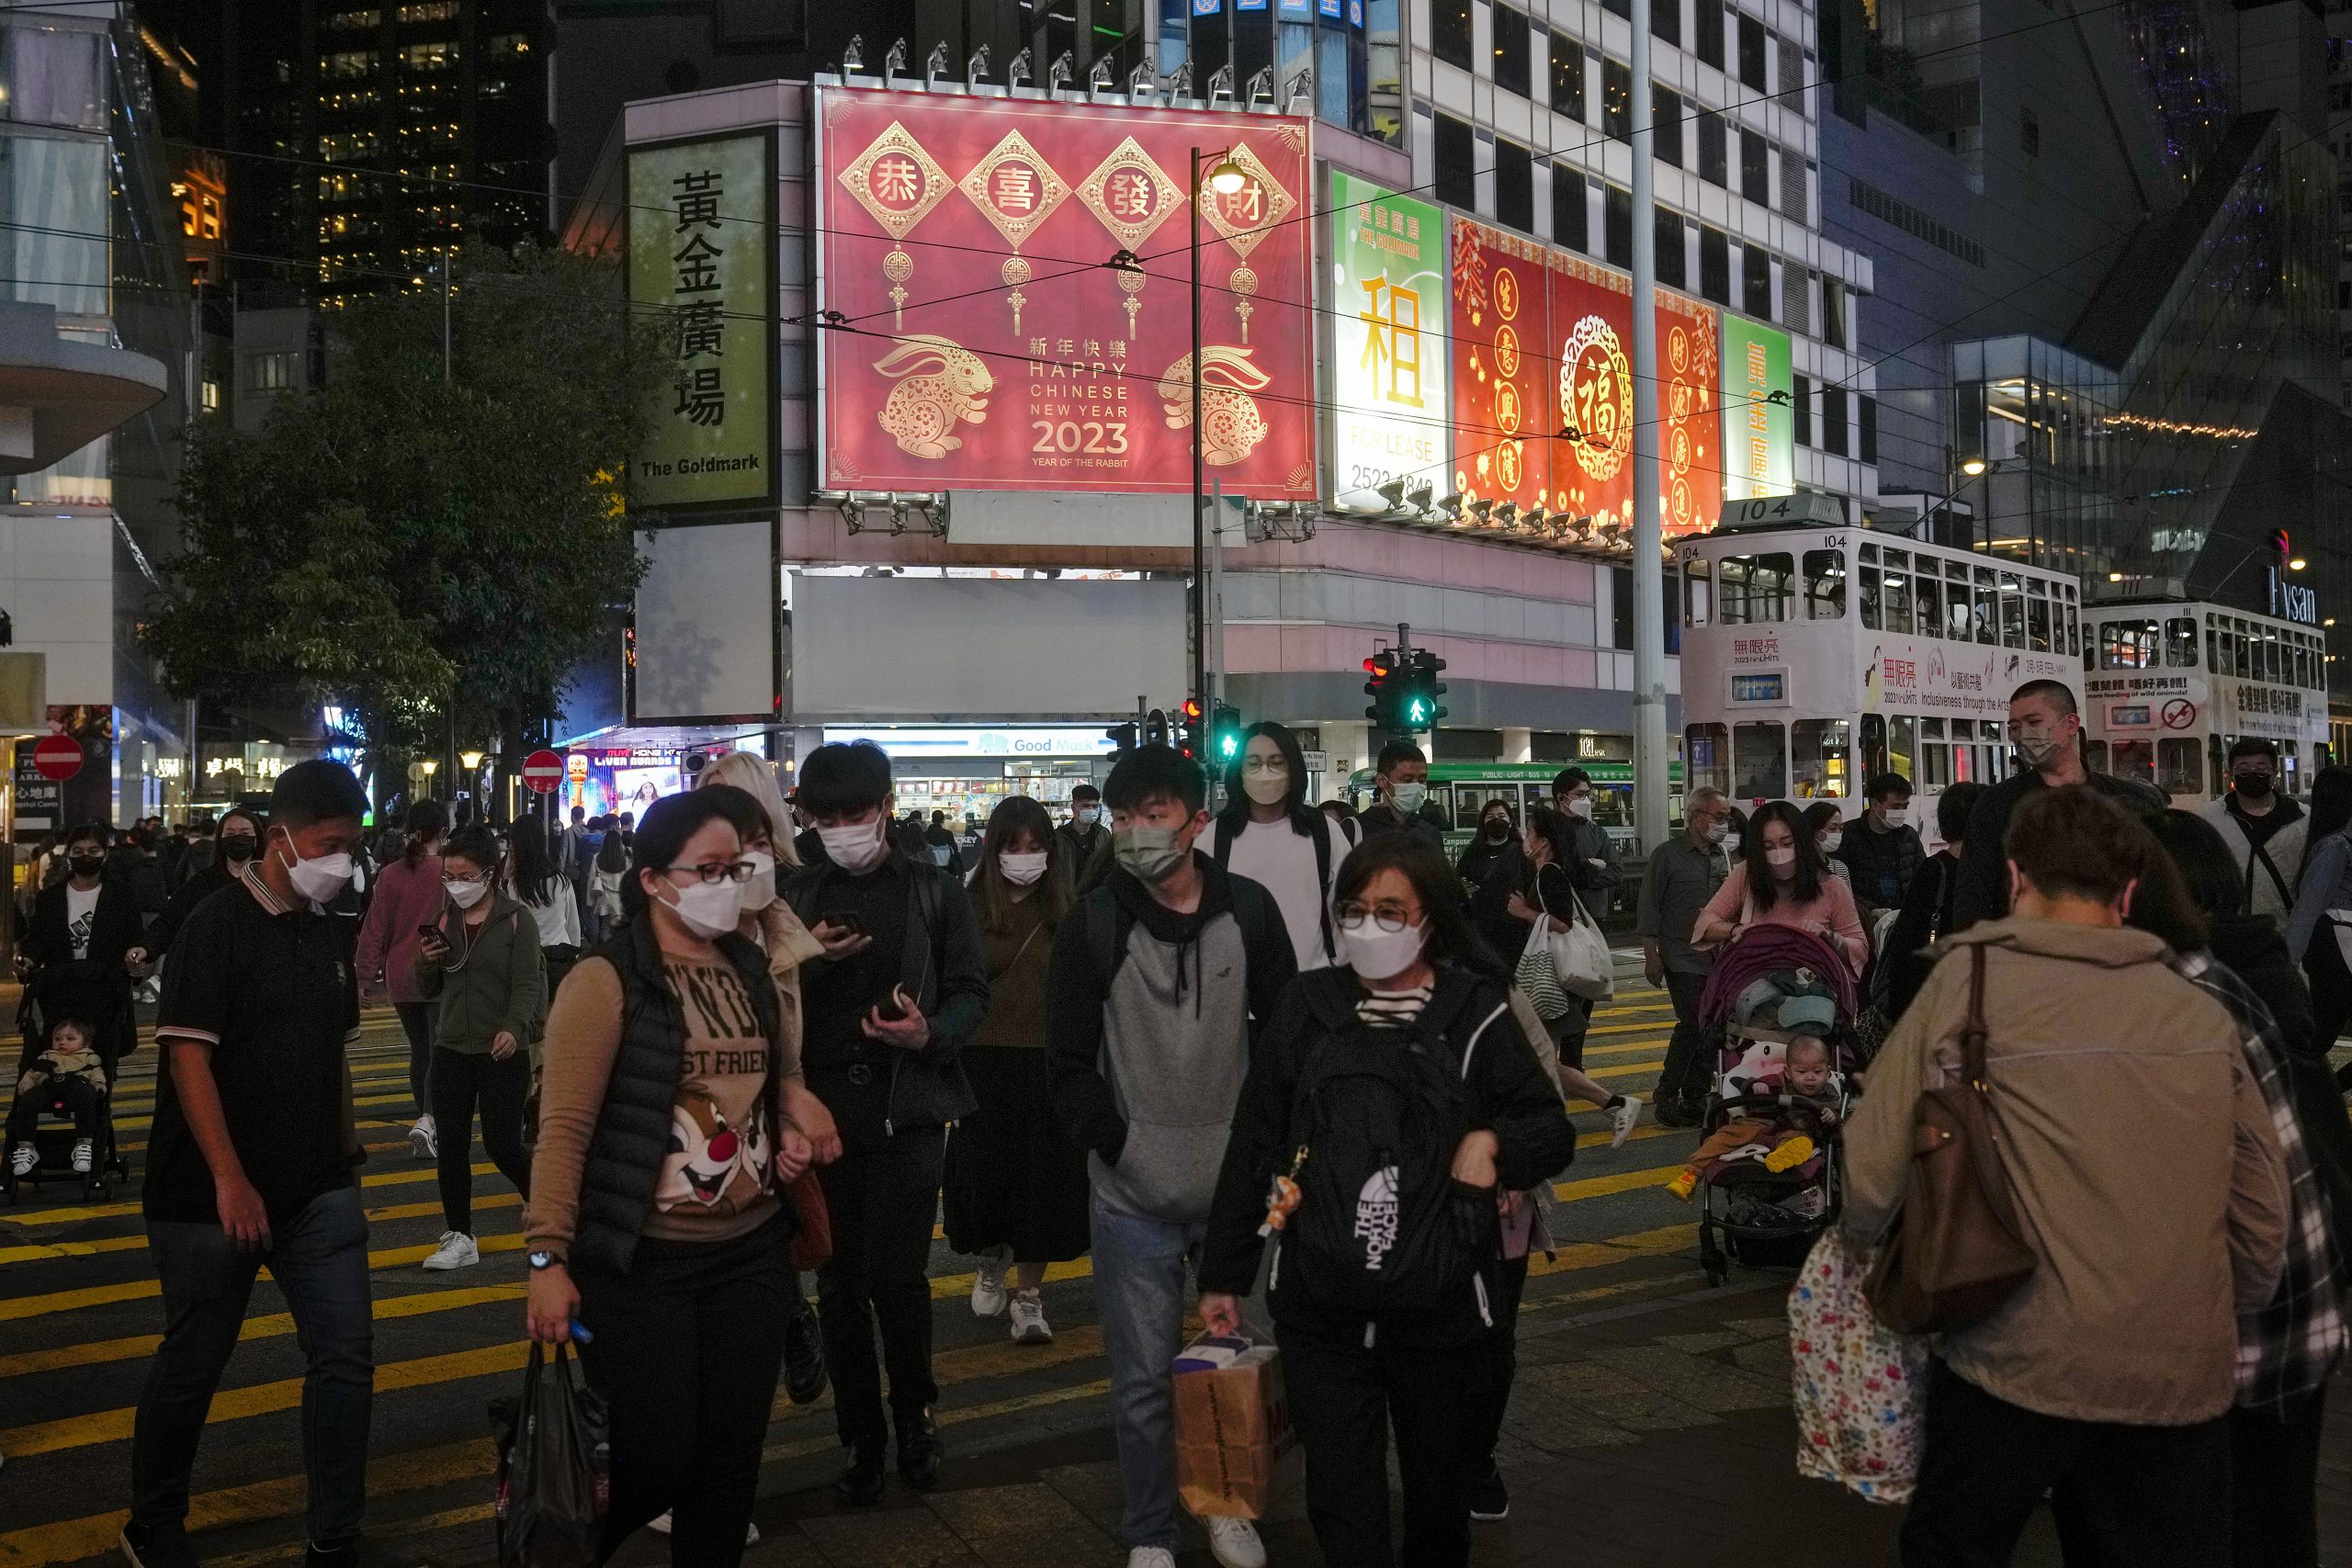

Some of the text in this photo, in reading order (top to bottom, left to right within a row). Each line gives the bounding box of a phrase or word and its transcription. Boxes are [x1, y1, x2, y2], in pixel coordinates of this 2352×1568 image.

[1360, 226, 1419, 261] THE GOLDMARK
[672, 169, 725, 427] 黃金廣場
[1030, 337, 1126, 358] 新年快樂
[1360, 275, 1424, 410] 租
[1030, 360, 1126, 379] HAPPY
[1497, 277, 1517, 485] 生意興隆
[1030, 384, 1127, 400] CHINESE
[1577, 356, 1616, 443] 福
[1031, 404, 1127, 417] NEW YEAR
[1032, 421, 1128, 455] 2023
[1351, 426, 1433, 463] FOR LEASE
[641, 455, 760, 478] The Goldmark
[1032, 458, 1057, 467] YEAR
[1060, 458, 1072, 467] OF
[1096, 459, 1128, 468] RABBIT
[1740, 499, 1791, 521] 104
[1682, 547, 1700, 559] 104
[1825, 535, 1848, 548] 104
[1734, 634, 1780, 655] 無限亮
[1883, 657, 1917, 688] 無限亮
[1921, 691, 1962, 707] Inclusiveness
[1963, 695, 1986, 714] through
[1987, 696, 1996, 711] the
[1014, 739, 1093, 751] Good Mask
[680, 1050, 710, 1075] ST
[1354, 1201, 1372, 1238] THE
[1381, 1201, 1398, 1250] FACE
[1365, 1202, 1385, 1269] NORTH
